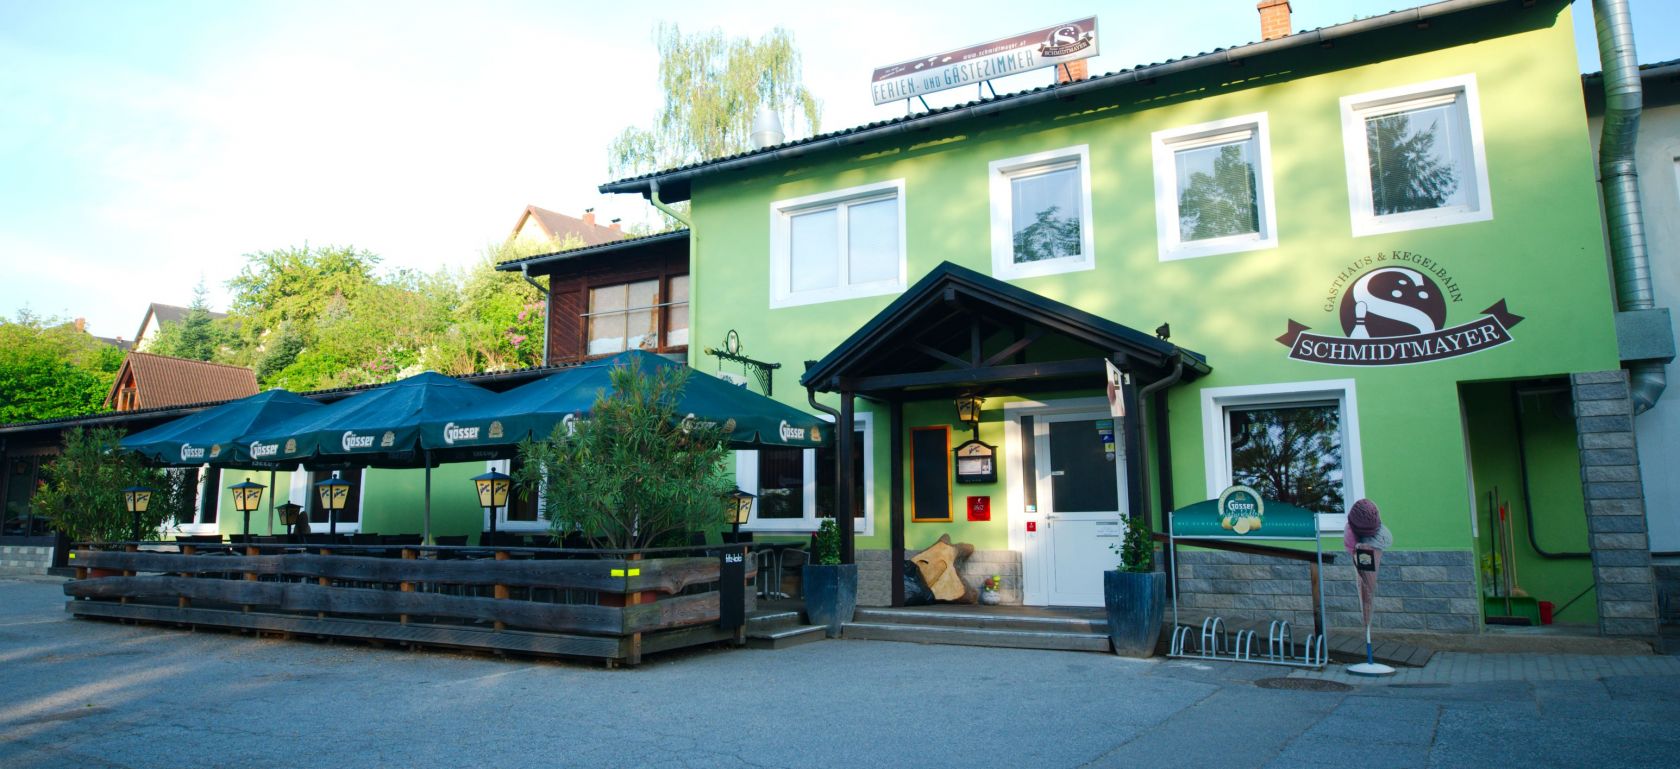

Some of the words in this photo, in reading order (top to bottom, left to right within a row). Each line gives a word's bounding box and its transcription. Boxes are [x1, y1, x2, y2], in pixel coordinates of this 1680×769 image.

[943, 49, 1034, 85] GÄSTEZIMMER
[1324, 256, 1373, 313] GASTHAUS
[1391, 250, 1463, 303] KEGELBAHN
[1299, 323, 1501, 362] SCHMIDTMAYER
[341, 430, 376, 451] Gösser
[443, 422, 481, 444] Gösser
[780, 419, 806, 443] Gösser
[180, 443, 206, 462] Gösser
[249, 440, 280, 460] Gösser
[1227, 499, 1255, 511] Gösser
